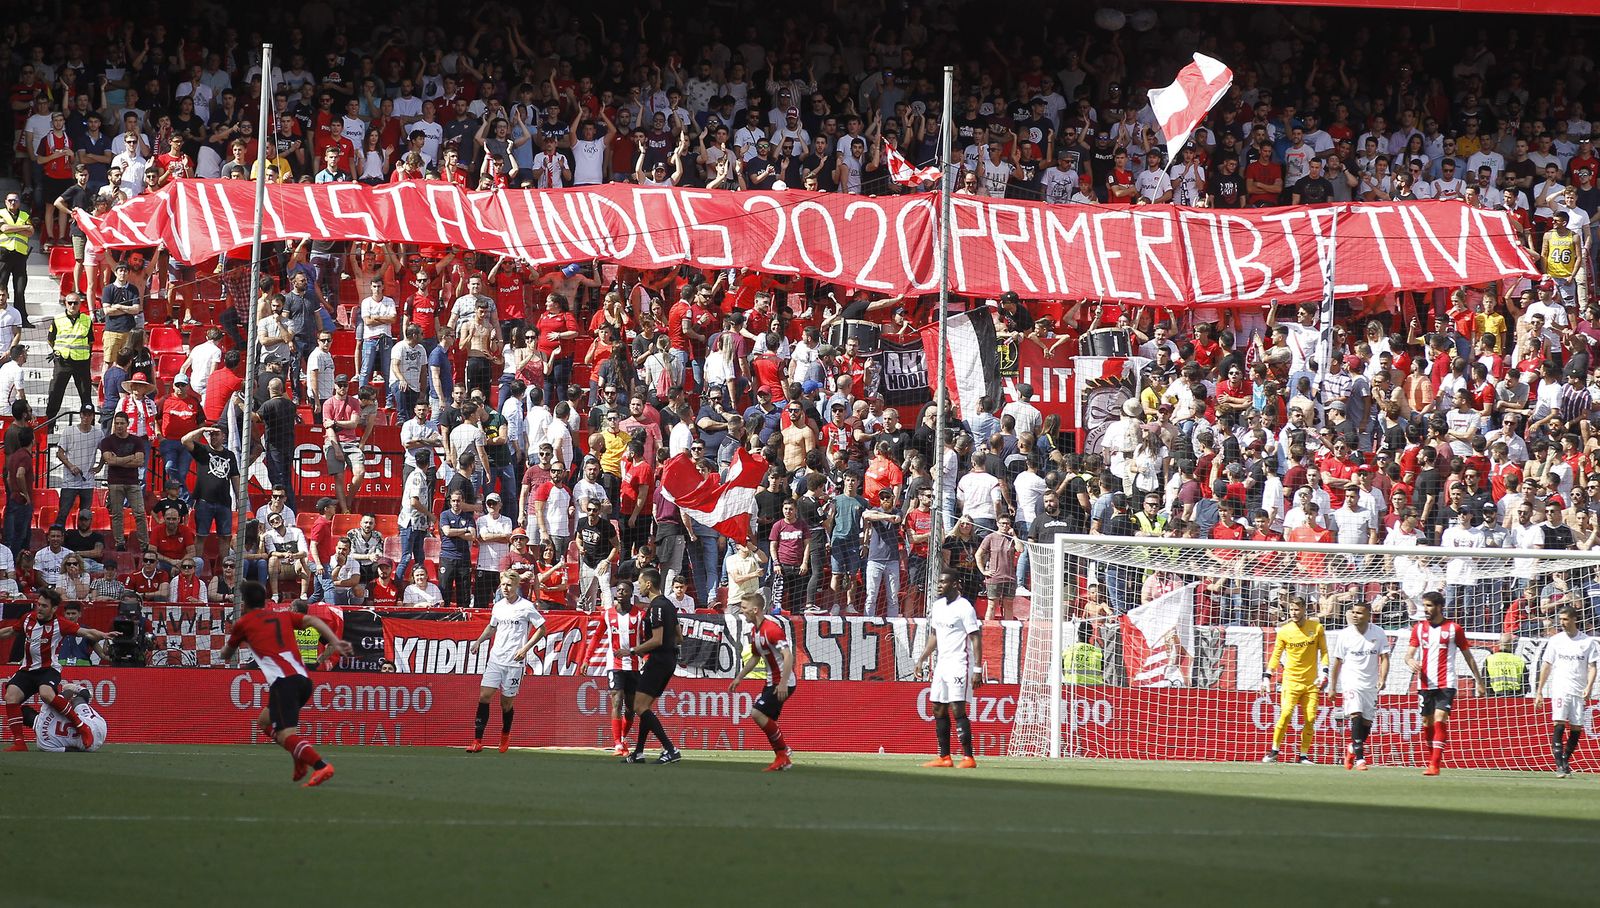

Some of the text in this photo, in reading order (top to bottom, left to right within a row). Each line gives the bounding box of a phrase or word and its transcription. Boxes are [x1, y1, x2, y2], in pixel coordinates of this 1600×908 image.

[497, 188, 732, 267] UNIDOS
[744, 197, 942, 292] 2020
[950, 196, 1186, 302] PRIMER
[1179, 205, 1541, 303] OBJETIVO
[1551, 249, 1571, 264] 46
[29, 373, 41, 381] F11
[265, 617, 284, 648] 7
[298, 629, 311, 638] 622
[525, 628, 583, 676] SFC
[229, 672, 433, 719] Crcampo
[576, 679, 763, 725] Crcamp
[41, 711, 56, 741] AMADOU
[55, 720, 82, 738] 5
[251, 719, 412, 747] EPECIAL
[597, 725, 748, 753] ECIAL
